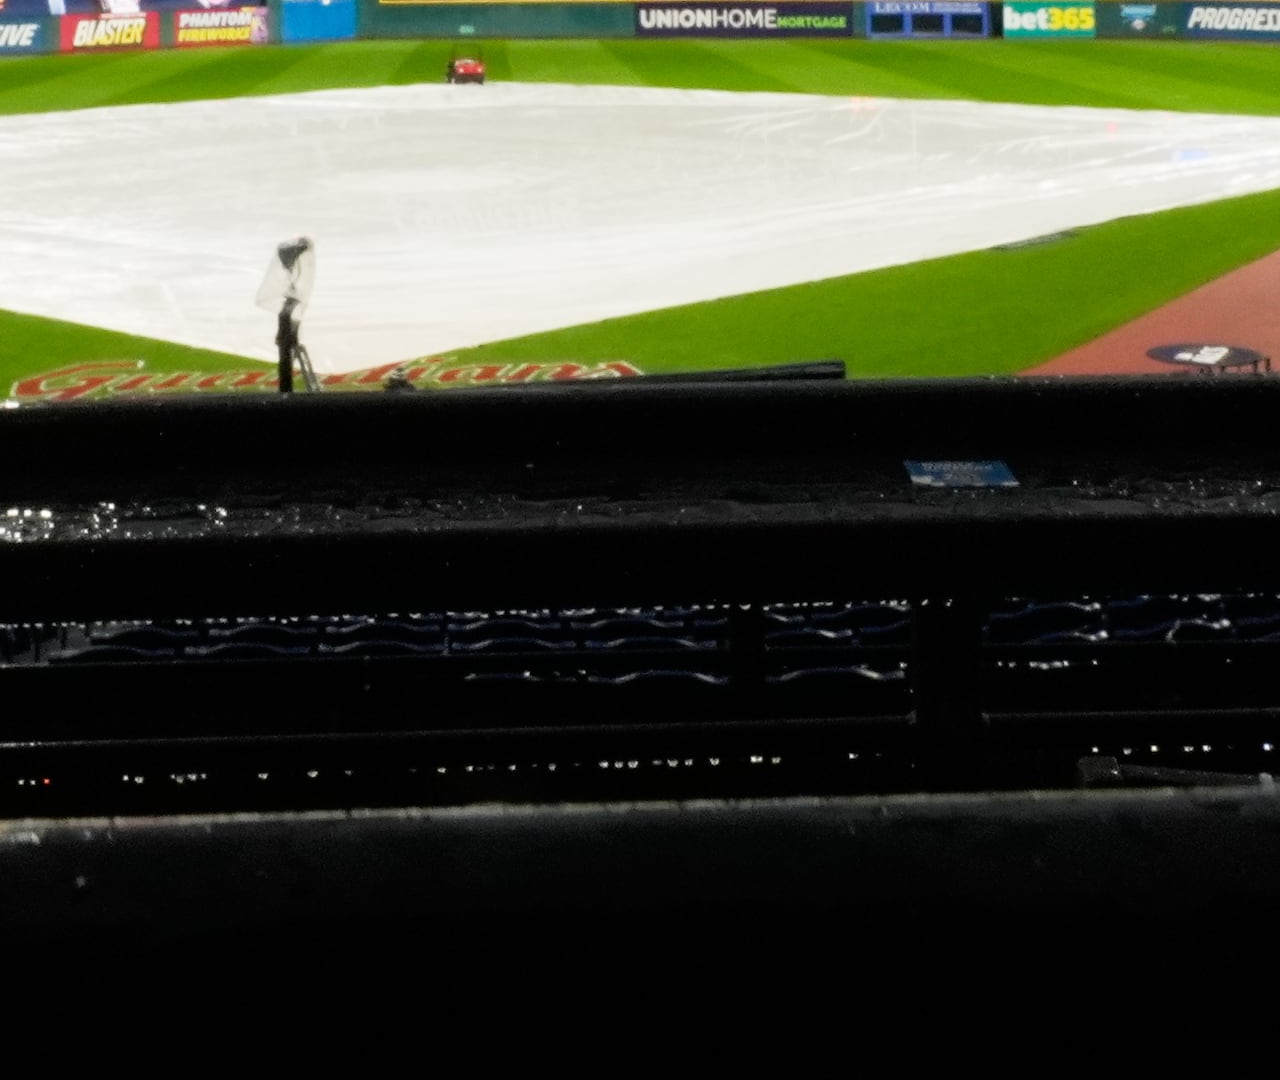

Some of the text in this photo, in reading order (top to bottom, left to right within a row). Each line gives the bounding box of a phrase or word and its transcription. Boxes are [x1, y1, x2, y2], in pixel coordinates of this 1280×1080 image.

[179, 11, 253, 28] PHANTOM
[1003, 6, 1095, 31] bet365
[73, 18, 146, 47] BLASTER
[178, 27, 251, 42] FIREWORKS
